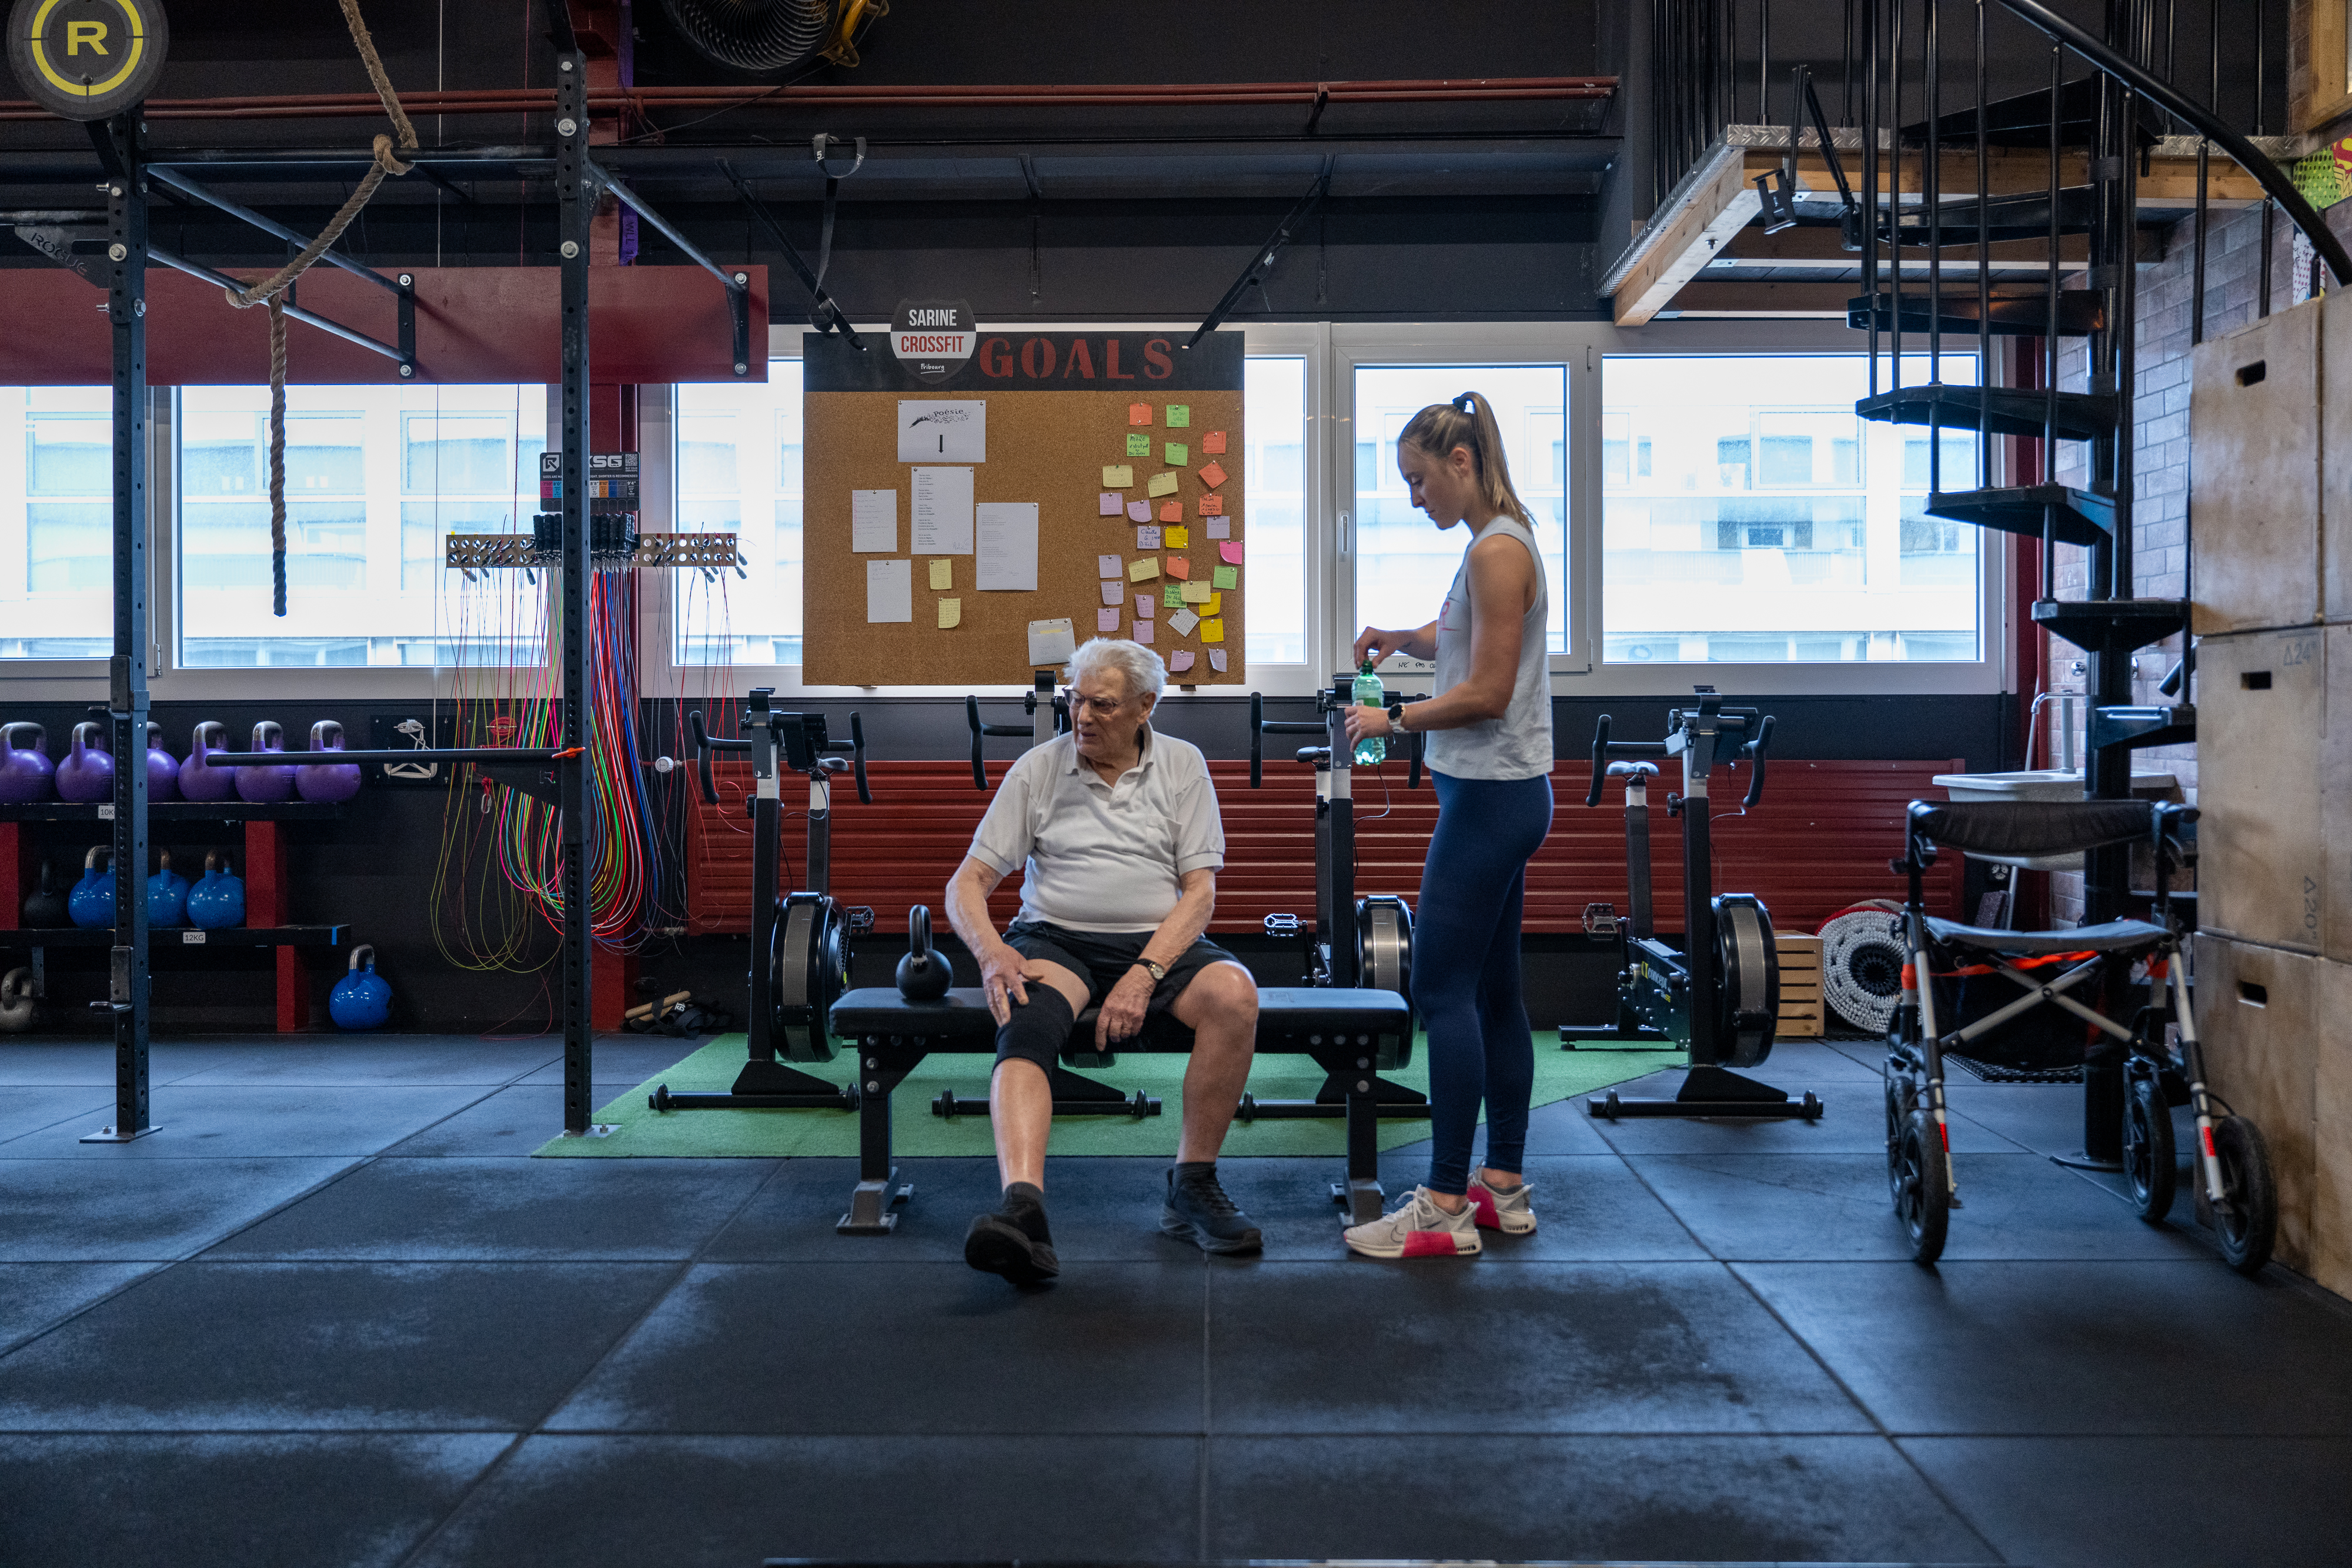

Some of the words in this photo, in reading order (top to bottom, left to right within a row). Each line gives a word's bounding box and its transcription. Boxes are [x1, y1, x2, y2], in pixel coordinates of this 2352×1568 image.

[68, 21, 109, 56] R
[817, 151, 822, 159] 5
[31, 233, 87, 276] ROGUE
[909, 309, 957, 326] SARINE
[901, 336, 964, 353] CROSSFIT
[979, 337, 1174, 380] GOALS
